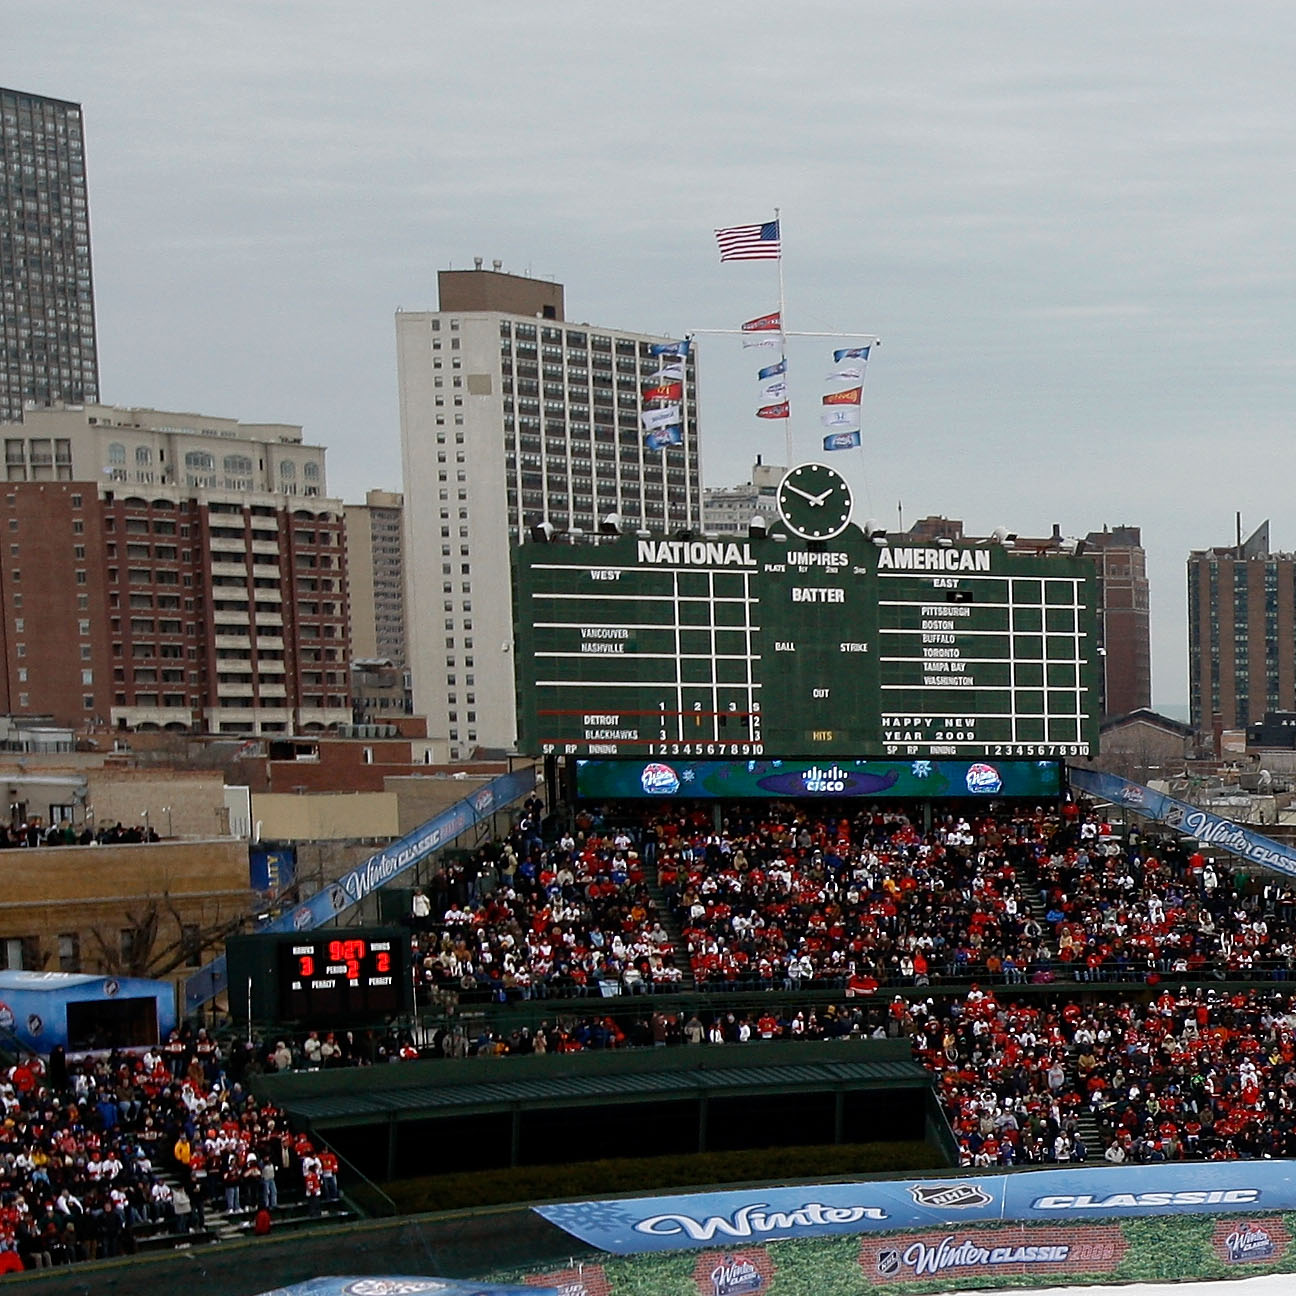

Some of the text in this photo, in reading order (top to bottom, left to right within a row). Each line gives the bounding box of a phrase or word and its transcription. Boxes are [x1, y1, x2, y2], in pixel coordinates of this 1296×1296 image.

[638, 541, 757, 566] NATIONAL
[787, 552, 848, 566] UMPIRES
[878, 548, 990, 571] AMERICAN
[590, 570, 622, 580] WEST
[934, 578, 960, 588] EAST
[792, 588, 844, 602] BATTER
[921, 606, 970, 616] PITTSBURGH
[922, 620, 954, 630] BOSTON
[581, 628, 628, 638] VANCOUVER
[922, 634, 956, 644] BUFFALO
[581, 643, 624, 654] NASHVILLE
[774, 642, 796, 652] BALL
[840, 643, 868, 652] STRIKE
[923, 648, 960, 658] TORONTO
[923, 662, 966, 672] TAMPA BAY
[924, 676, 974, 686] WASHINGTON
[812, 688, 830, 698] OUT
[659, 702, 737, 712] 1 2 3
[584, 715, 760, 726] DETROIT 2
[882, 718, 976, 727] HAPPY NEW
[585, 730, 760, 741] BLACKHAWKS 3 3
[812, 731, 832, 740] HITS
[884, 732, 975, 740] YEAR 2009
[542, 744, 554, 754] SP
[565, 744, 578, 754] RP
[649, 744, 654, 754] 1
[660, 744, 668, 754] 2
[672, 744, 680, 754] 3
[683, 744, 691, 754] 4
[696, 744, 702, 754] 5
[707, 744, 714, 754] 6
[719, 744, 726, 754] 7
[730, 744, 738, 754] 8
[742, 744, 750, 754] 9
[752, 744, 764, 754] 10
[887, 746, 898, 755] SP
[907, 746, 918, 755] RP
[984, 746, 989, 756] 1
[994, 746, 1002, 756] 2
[1005, 746, 1012, 756] 3
[1016, 746, 1023, 756] 4
[1027, 746, 1034, 756] 5
[1038, 746, 1044, 756] 6
[1049, 746, 1056, 756] 7
[1060, 746, 1066, 756] 8
[1070, 746, 1077, 756] 9
[1079, 746, 1090, 756] 10
[806, 781, 844, 792] CISCO
[1186, 812, 1251, 854] Winter
[346, 829, 441, 900] Winter CLASSIC
[300, 952, 390, 976] 3 2
[326, 965, 348, 974] PERIOD
[933, 1187, 971, 1207] NHL
[635, 1188, 1261, 1241] Winter CLASSIC
[1226, 1229, 1268, 1252] Winter
[902, 1236, 1115, 1275] Winter CLASSIC 2009
[711, 1262, 754, 1287] Winter
